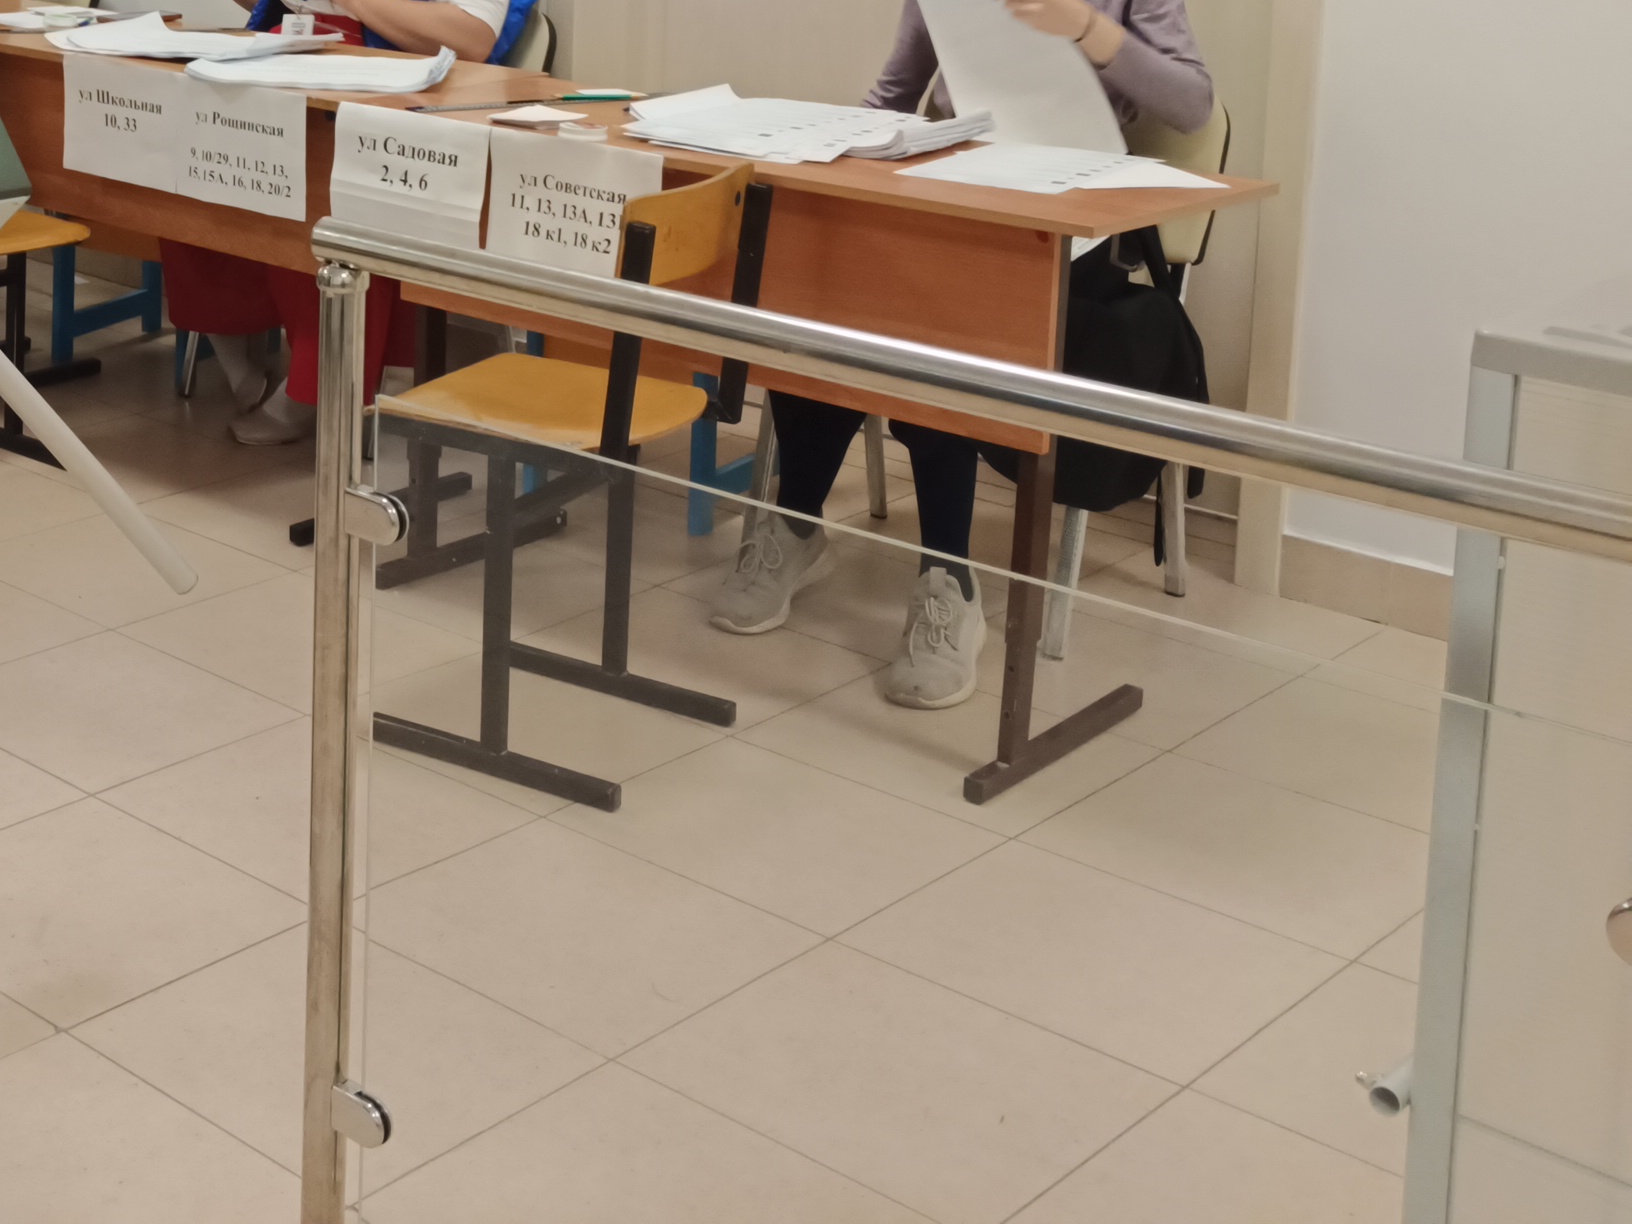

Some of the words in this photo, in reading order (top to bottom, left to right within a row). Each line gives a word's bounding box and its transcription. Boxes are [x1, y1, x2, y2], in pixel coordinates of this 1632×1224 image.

[78, 89, 93, 104] ул
[96, 89, 163, 115] Школьная
[104, 113, 120, 131] 10,
[123, 116, 138, 133] 33
[195, 111, 208, 126] ул
[212, 111, 285, 138] Рощинская
[357, 135, 377, 153] ул
[383, 136, 459, 167] Садовая
[236, 156, 251, 172] 11,
[254, 160, 268, 176] 12,
[272, 164, 289, 180] 13,
[380, 165, 394, 186] 2,
[399, 168, 413, 192] 4,
[418, 173, 429, 192] 6
[232, 174, 247, 191] 16,
[250, 178, 265, 195] 18,
[268, 182, 292, 198] 20/2
[519, 173, 538, 189] ул
[542, 174, 627, 206] Советская
[510, 192, 530, 213] 11,
[536, 198, 556, 219] 13,
[561, 203, 593, 227] 13А,
[597, 212, 622, 230] 13
[523, 220, 541, 239] 18
[572, 231, 588, 249] 18
[591, 238, 612, 255] к2
